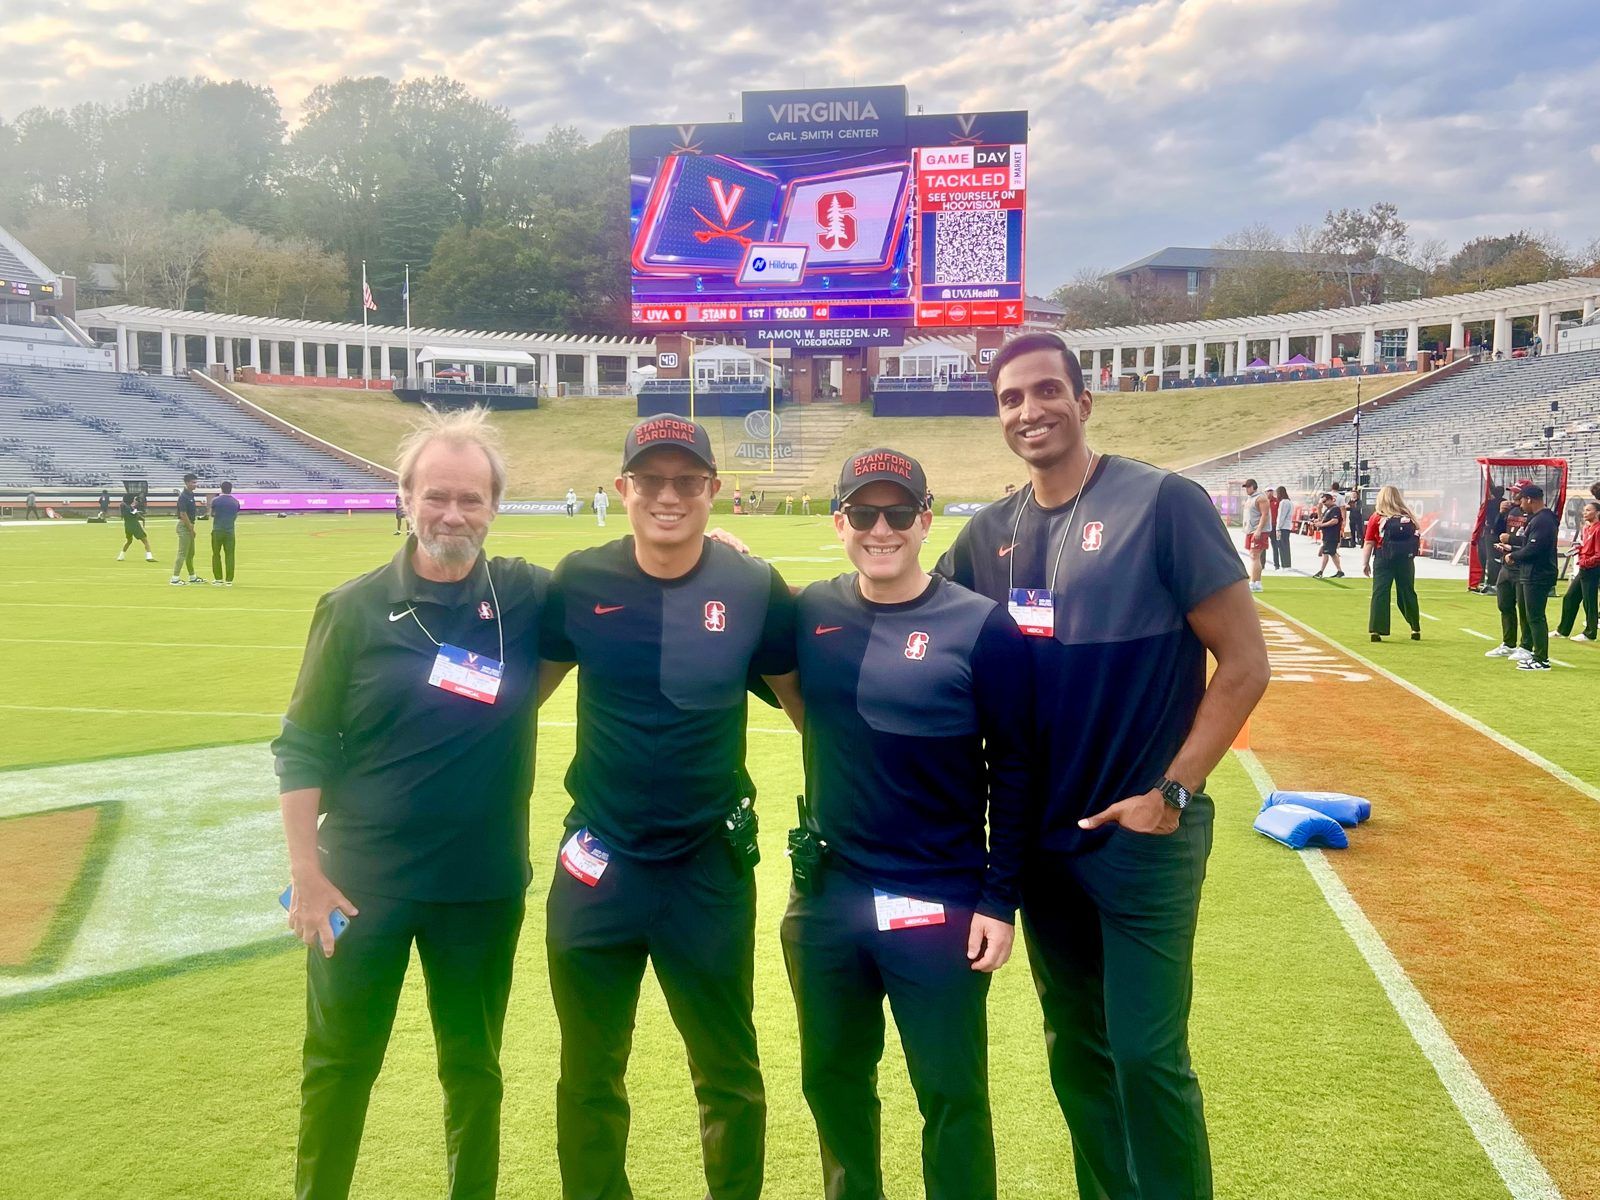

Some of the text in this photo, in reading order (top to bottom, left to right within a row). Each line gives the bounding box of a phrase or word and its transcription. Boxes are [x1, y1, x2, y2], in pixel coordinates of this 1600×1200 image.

[768, 101, 880, 124] VIRGINIA
[768, 129, 879, 141] CARL SMITH CENTER
[926, 152, 1007, 165] GAME DAY
[925, 173, 1006, 188] TACKLED
[928, 191, 1015, 202] SEE YOURSELF ON
[942, 200, 1001, 210] HOOVISION
[647, 309, 670, 320] UVA
[674, 309, 682, 320] 0
[702, 309, 737, 320] STAN 0
[748, 308, 765, 318] 1ST
[776, 307, 807, 318] 90:00
[758, 330, 800, 339] RAMON
[804, 330, 815, 338] W.
[873, 328, 891, 337] JR.
[661, 355, 675, 365] 40
[636, 419, 695, 436] STANFORD
[637, 429, 695, 445] CARDINAL
[736, 443, 792, 458] Allstate
[854, 453, 912, 471] STANFORD
[855, 461, 912, 480] CARDINAL
[498, 503, 578, 511] RTHOPEDICS
